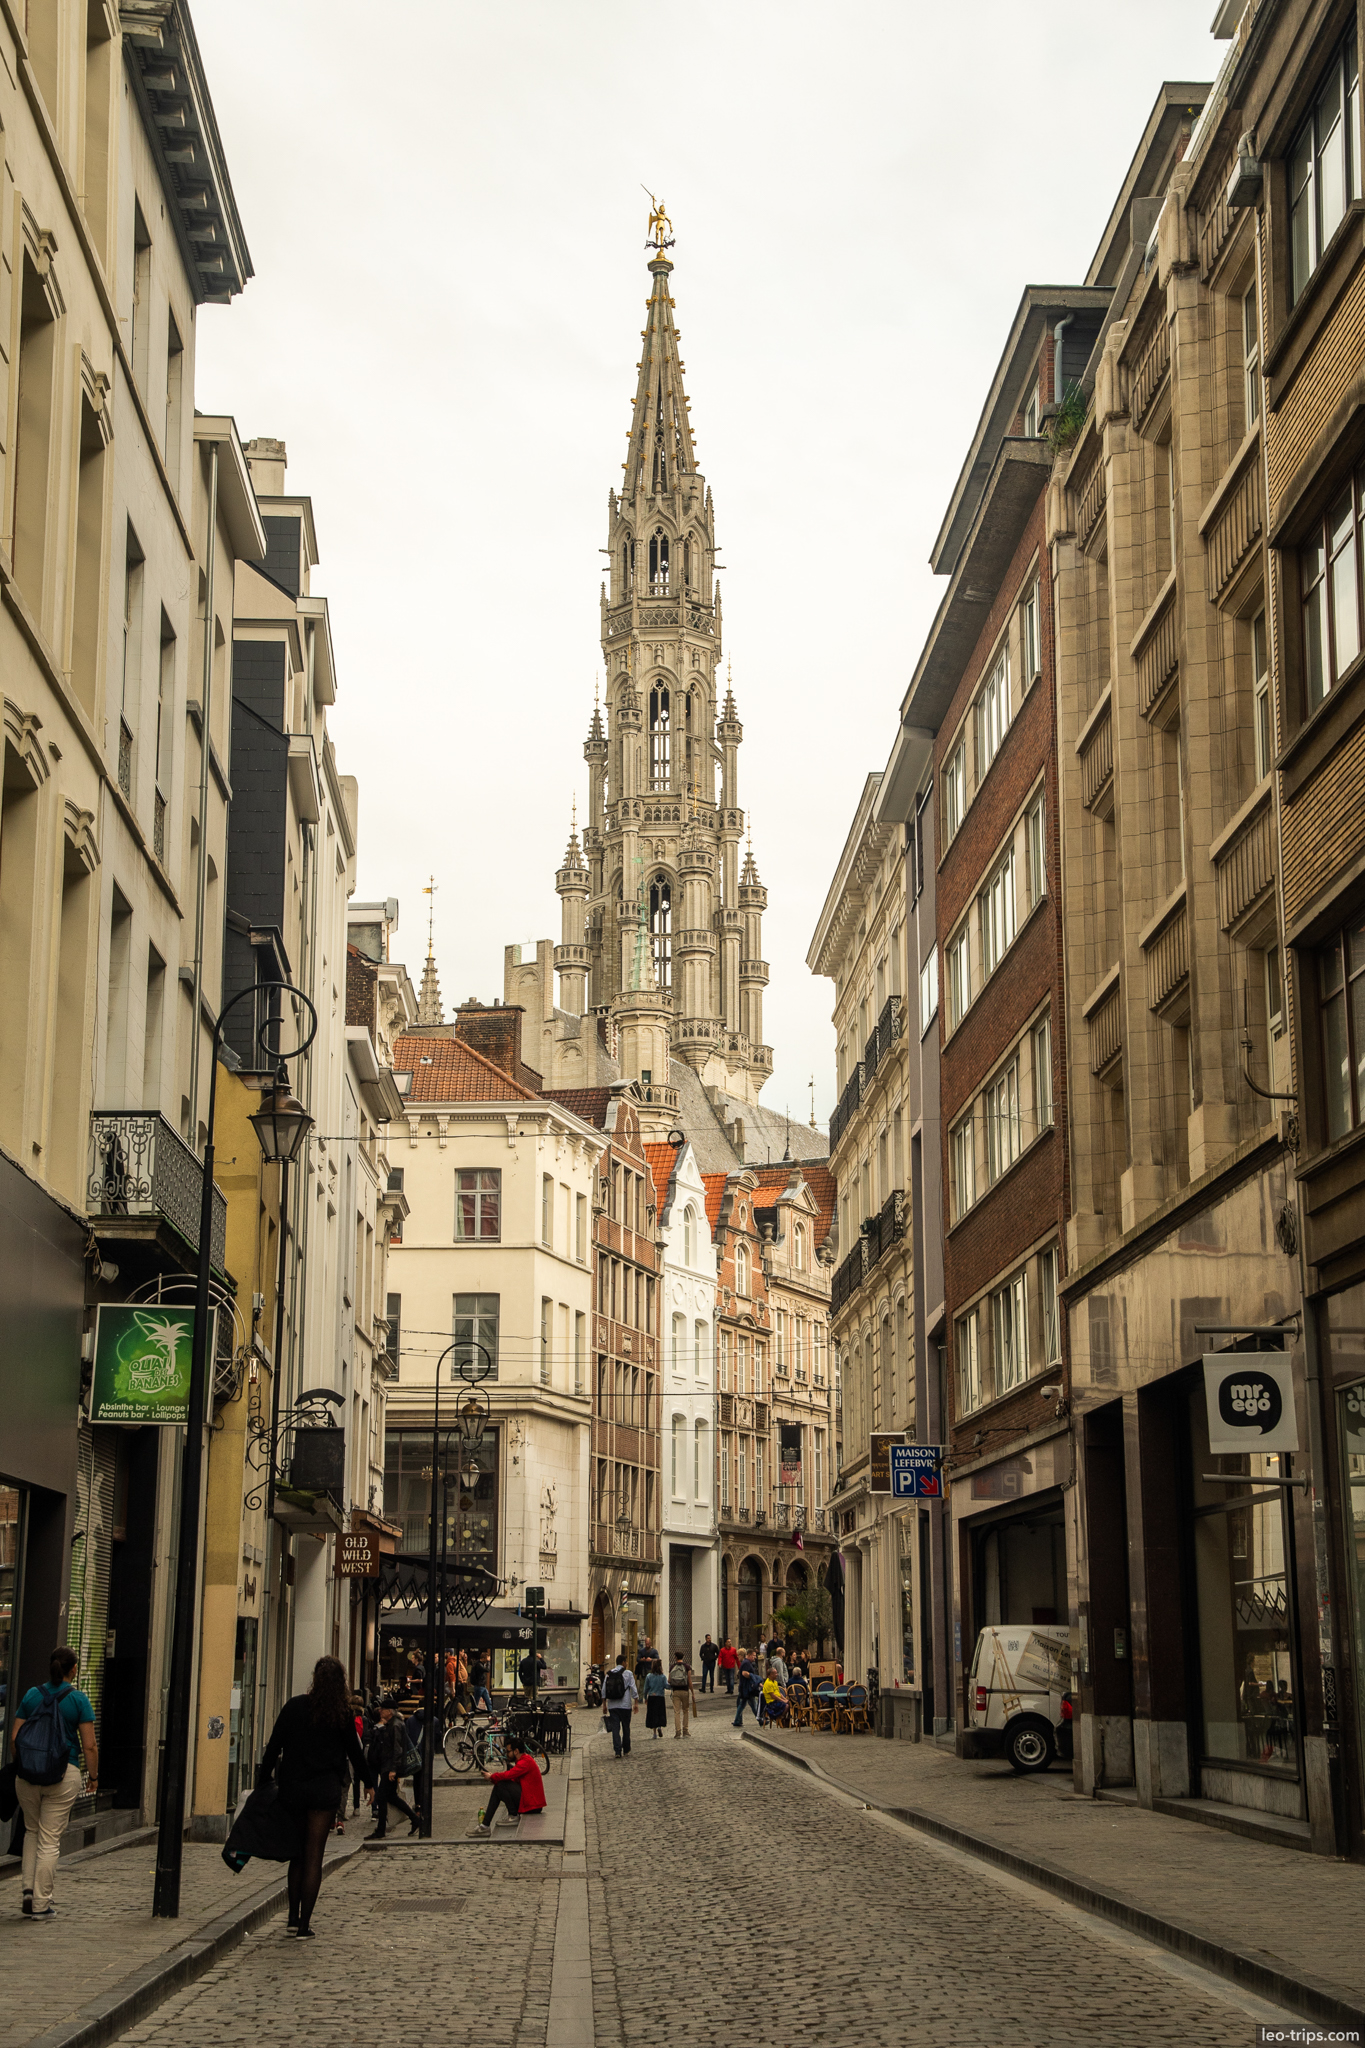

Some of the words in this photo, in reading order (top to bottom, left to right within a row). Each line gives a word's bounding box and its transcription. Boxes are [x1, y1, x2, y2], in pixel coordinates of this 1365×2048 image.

[129, 1356, 171, 1372] QUAI
[128, 1375, 179, 1390] BANANES
[1230, 1384, 1270, 1399] mr.
[99, 1403, 134, 1411] Absinthe
[156, 1404, 185, 1412] Lounge
[1231, 1398, 1271, 1417] ego
[152, 1412, 185, 1420] Lollipops
[896, 1448, 936, 1457] MAISON
[895, 1458, 937, 1468] LEFEBVR
[900, 1472, 912, 1492] P
[345, 1536, 368, 1548] OLD
[342, 1549, 371, 1560] WILD
[341, 1562, 372, 1573] WEST
[1032, 1638, 1059, 1654] Maison
